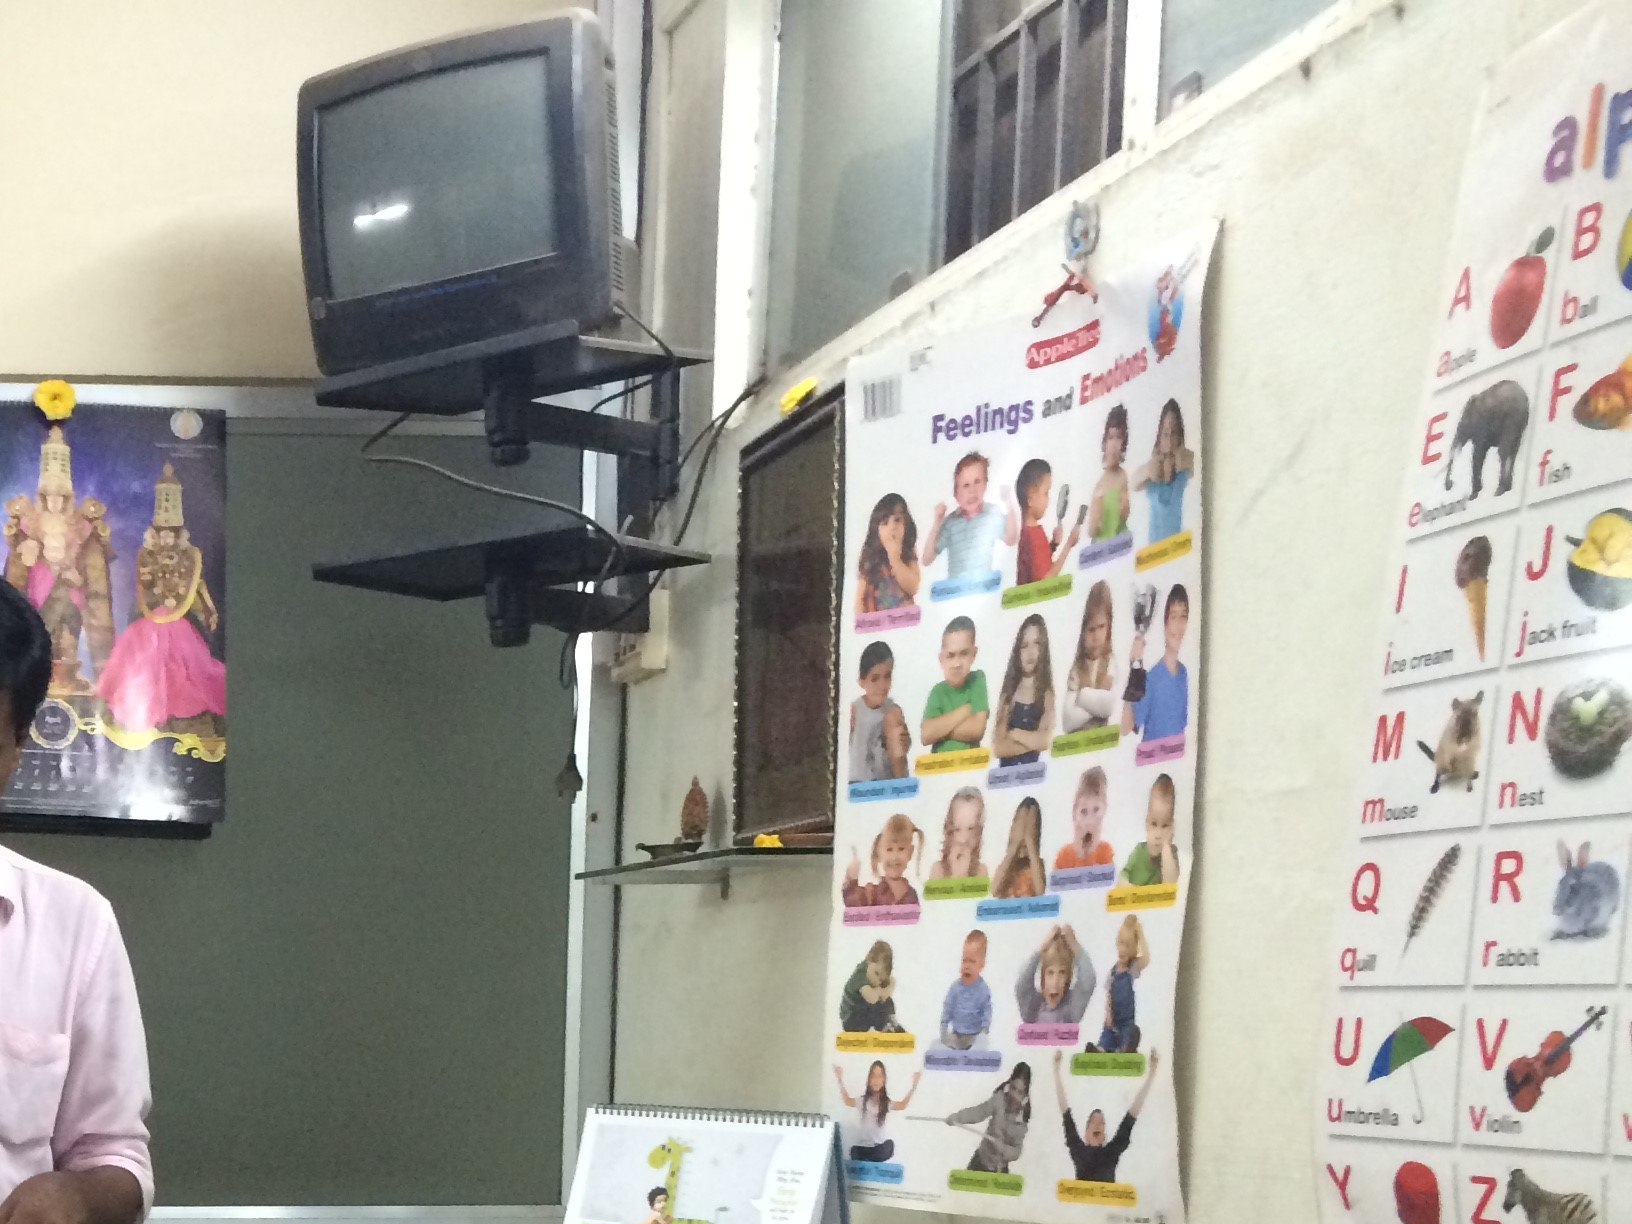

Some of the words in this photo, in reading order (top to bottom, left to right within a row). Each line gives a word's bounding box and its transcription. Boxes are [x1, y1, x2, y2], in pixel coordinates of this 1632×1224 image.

[1571, 201, 1603, 261] B
[1448, 265, 1472, 320] A
[932, 399, 1034, 444] Feelings
[1041, 386, 1075, 419] and
[1079, 346, 1149, 406] Emotions
[1548, 363, 1579, 422] F
[1421, 411, 1448, 465] E
[1538, 449, 1572, 487] fish
[1526, 524, 1553, 581] J
[1395, 564, 1408, 614] I
[1384, 641, 1407, 676] ice
[1410, 648, 1454, 670] cream
[1514, 611, 1557, 658] jack
[1561, 618, 1597, 640] fruit
[1372, 711, 1406, 763] M
[1508, 687, 1543, 744] N
[1361, 797, 1418, 824] mouse
[1498, 781, 1545, 809] nest
[1351, 862, 1381, 915] Q
[1490, 850, 1524, 904] R
[1482, 940, 1540, 967] rabbit
[1334, 1017, 1362, 1066] U
[1476, 1018, 1509, 1071] V
[1327, 1163, 1351, 1210] Y
